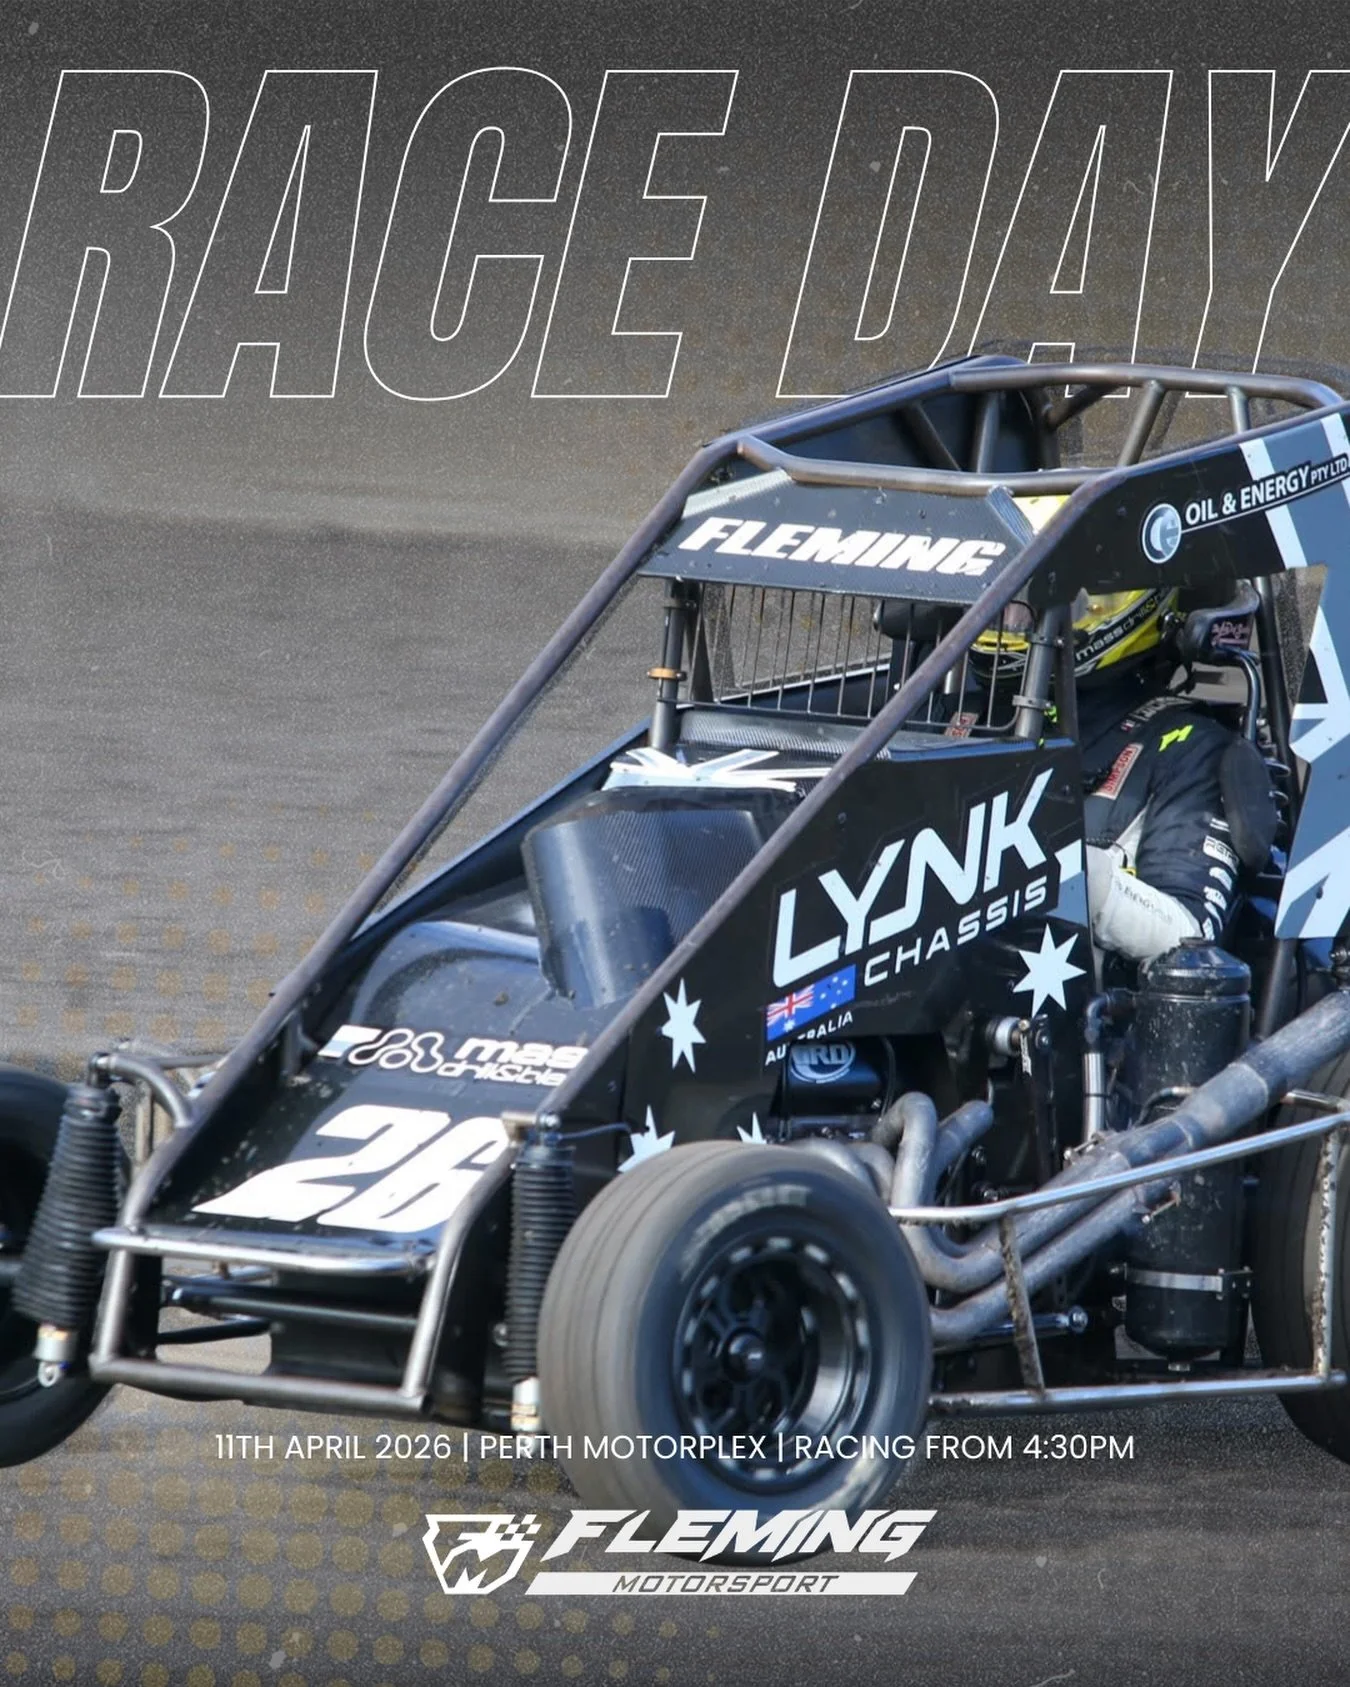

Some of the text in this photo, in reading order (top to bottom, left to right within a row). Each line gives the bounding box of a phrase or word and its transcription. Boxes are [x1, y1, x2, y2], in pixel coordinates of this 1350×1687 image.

[1185, 457, 1348, 525] OIL & ENERGY PTY LTD
[677, 516, 1007, 576] FLEMING
[773, 767, 1054, 988] LYNK
[864, 875, 1048, 987] CHASSIS
[764, 1010, 853, 1066] AURALIA
[191, 1104, 510, 1233] 26
